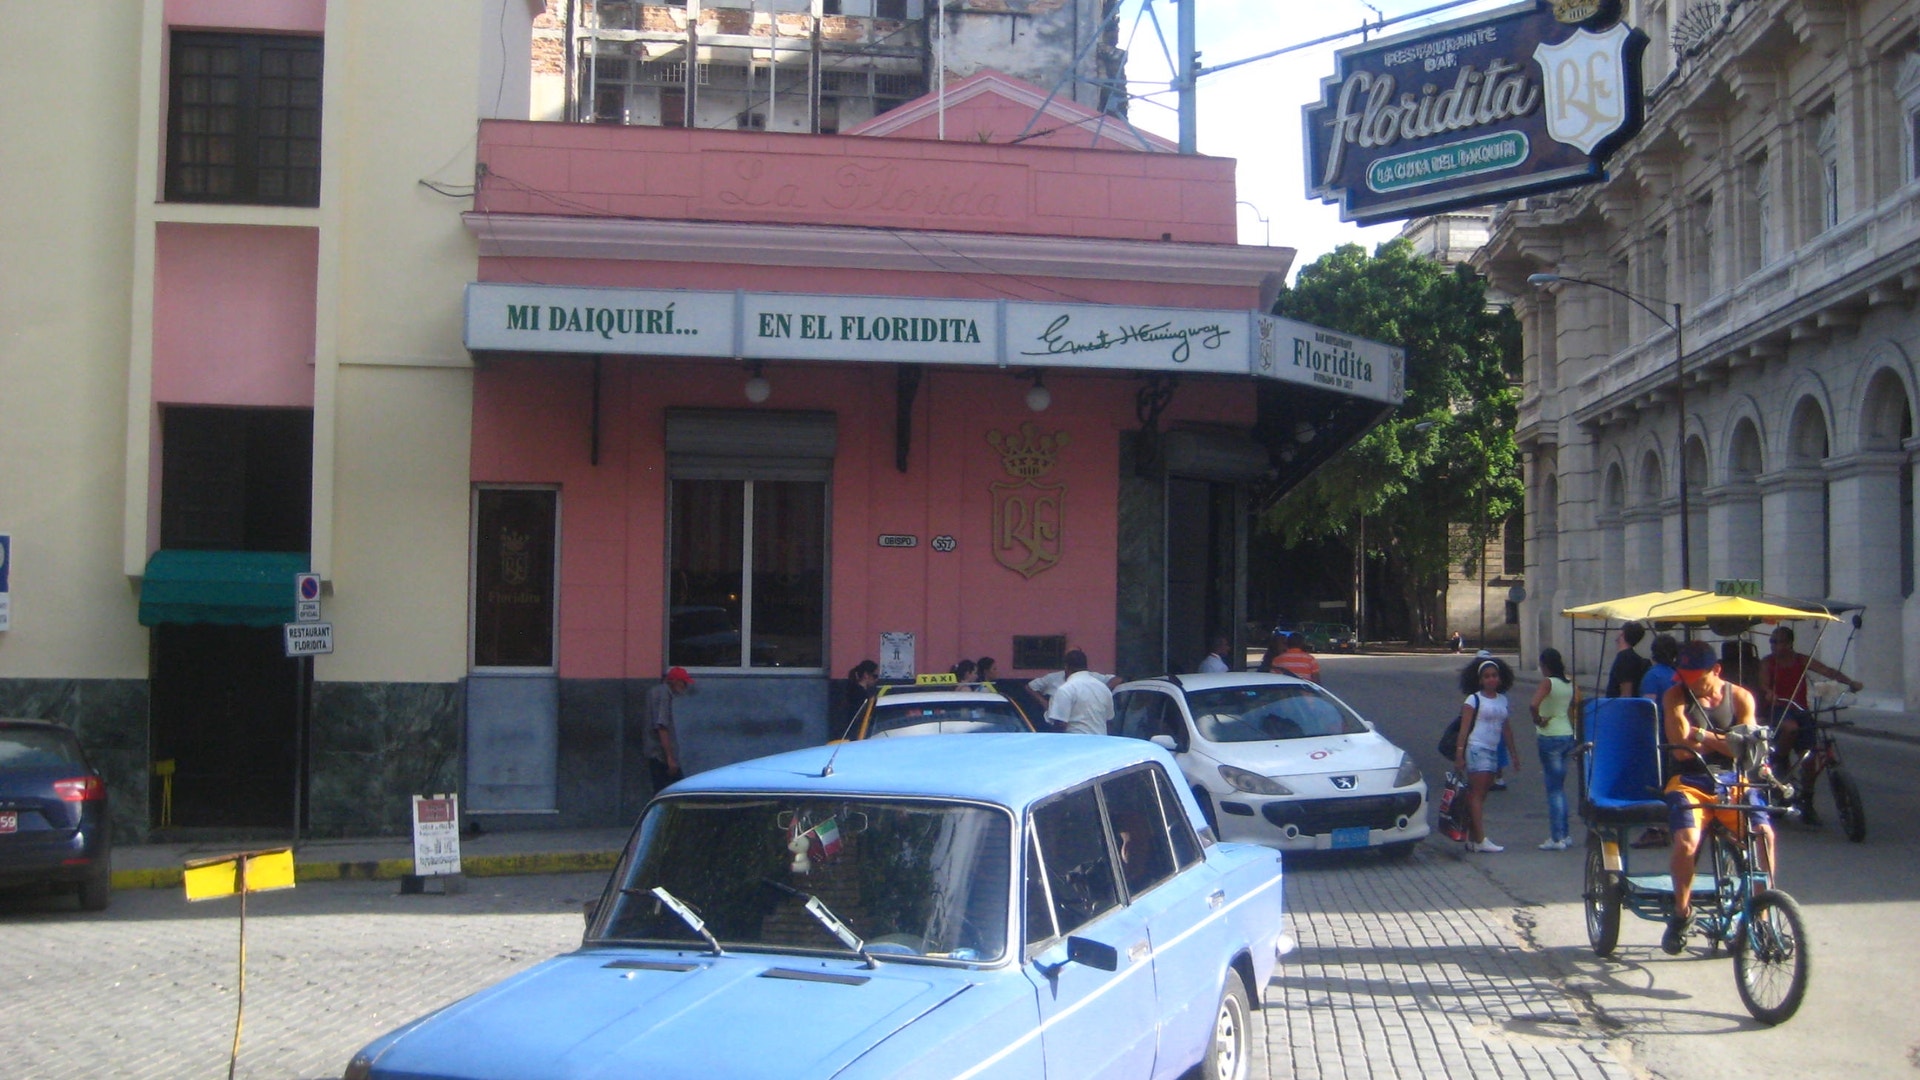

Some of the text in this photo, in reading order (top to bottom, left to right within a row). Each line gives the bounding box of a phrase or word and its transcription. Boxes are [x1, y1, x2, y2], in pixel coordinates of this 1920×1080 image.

[1384, 26, 1497, 67] RESTAURANTE
[1424, 52, 1457, 72] BAR
[1377, 167, 1394, 183] LA
[1394, 158, 1431, 180] CUNA
[1431, 154, 1457, 173] DEL
[507, 302, 699, 339] MI DAIQUIRÍ...
[758, 313, 981, 343] EN EL FLORIDITA
[1293, 337, 1372, 382] Floridita
[884, 537, 912, 545] OBISPO
[936, 539, 953, 549] 557
[1717, 581, 1756, 595] TAXI
[289, 627, 330, 638] RESTAURANT
[294, 640, 327, 651] FLORIDITA
